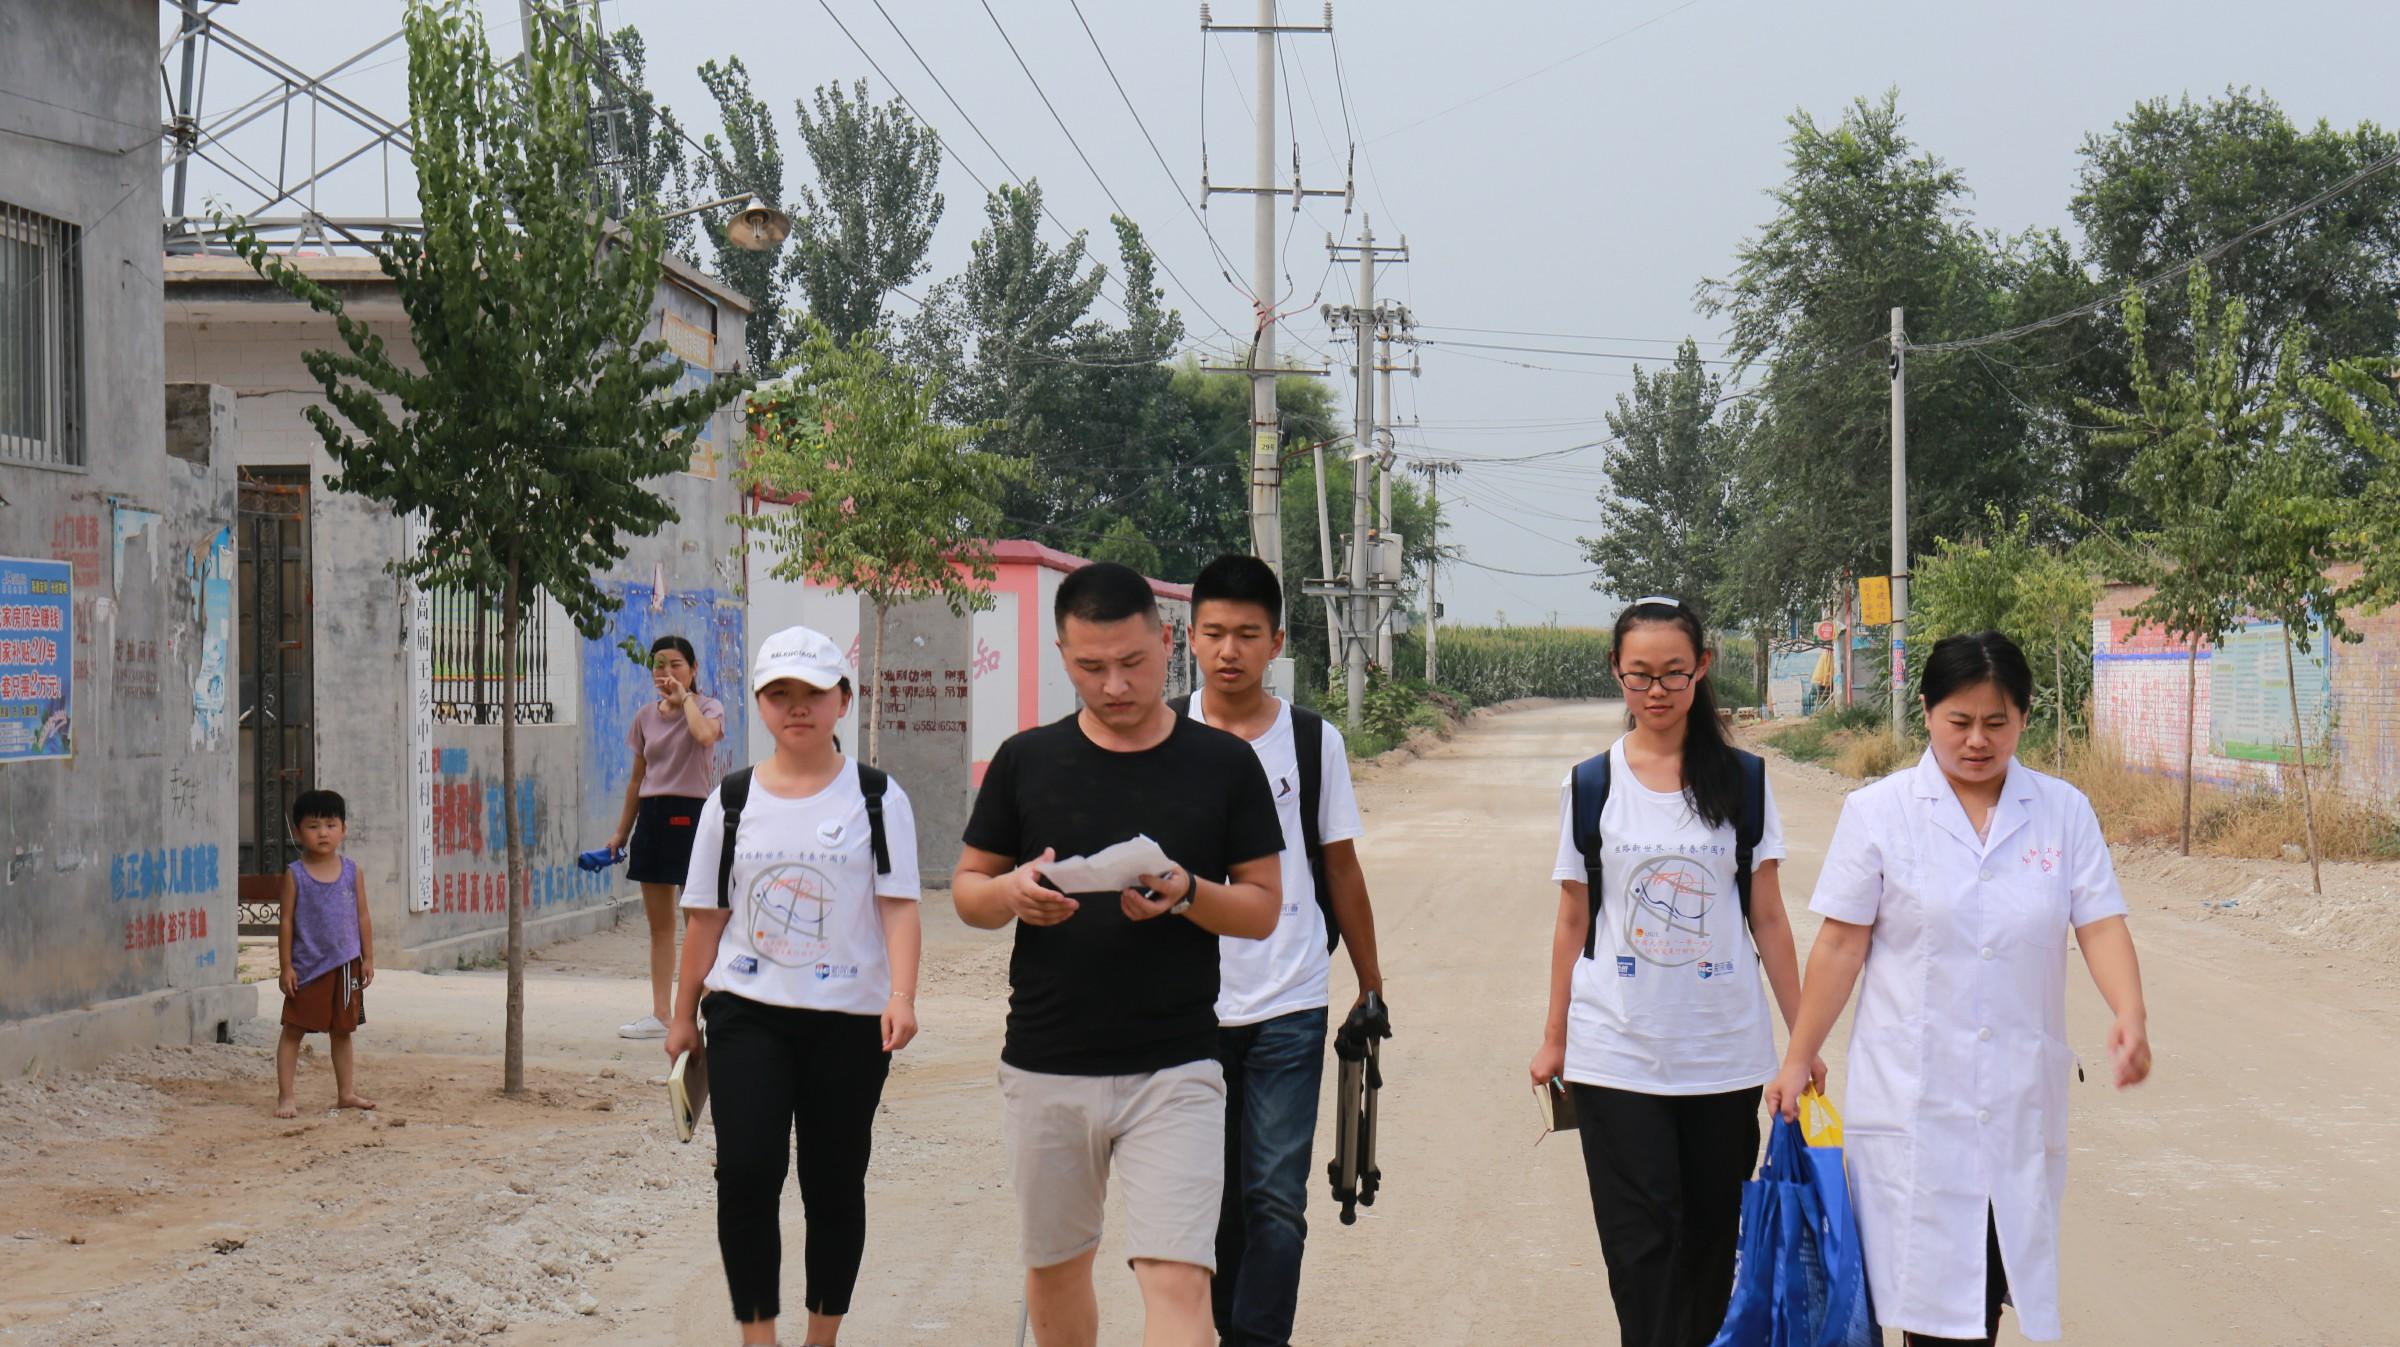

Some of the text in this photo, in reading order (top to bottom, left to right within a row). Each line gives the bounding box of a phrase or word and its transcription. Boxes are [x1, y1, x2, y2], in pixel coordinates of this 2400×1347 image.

[0, 605, 63, 631] 家房顶会赚钱!
[0, 637, 57, 665] 家补贴20年
[972, 638, 1001, 680] 知
[0, 670, 62, 700] 套只需2万元!
